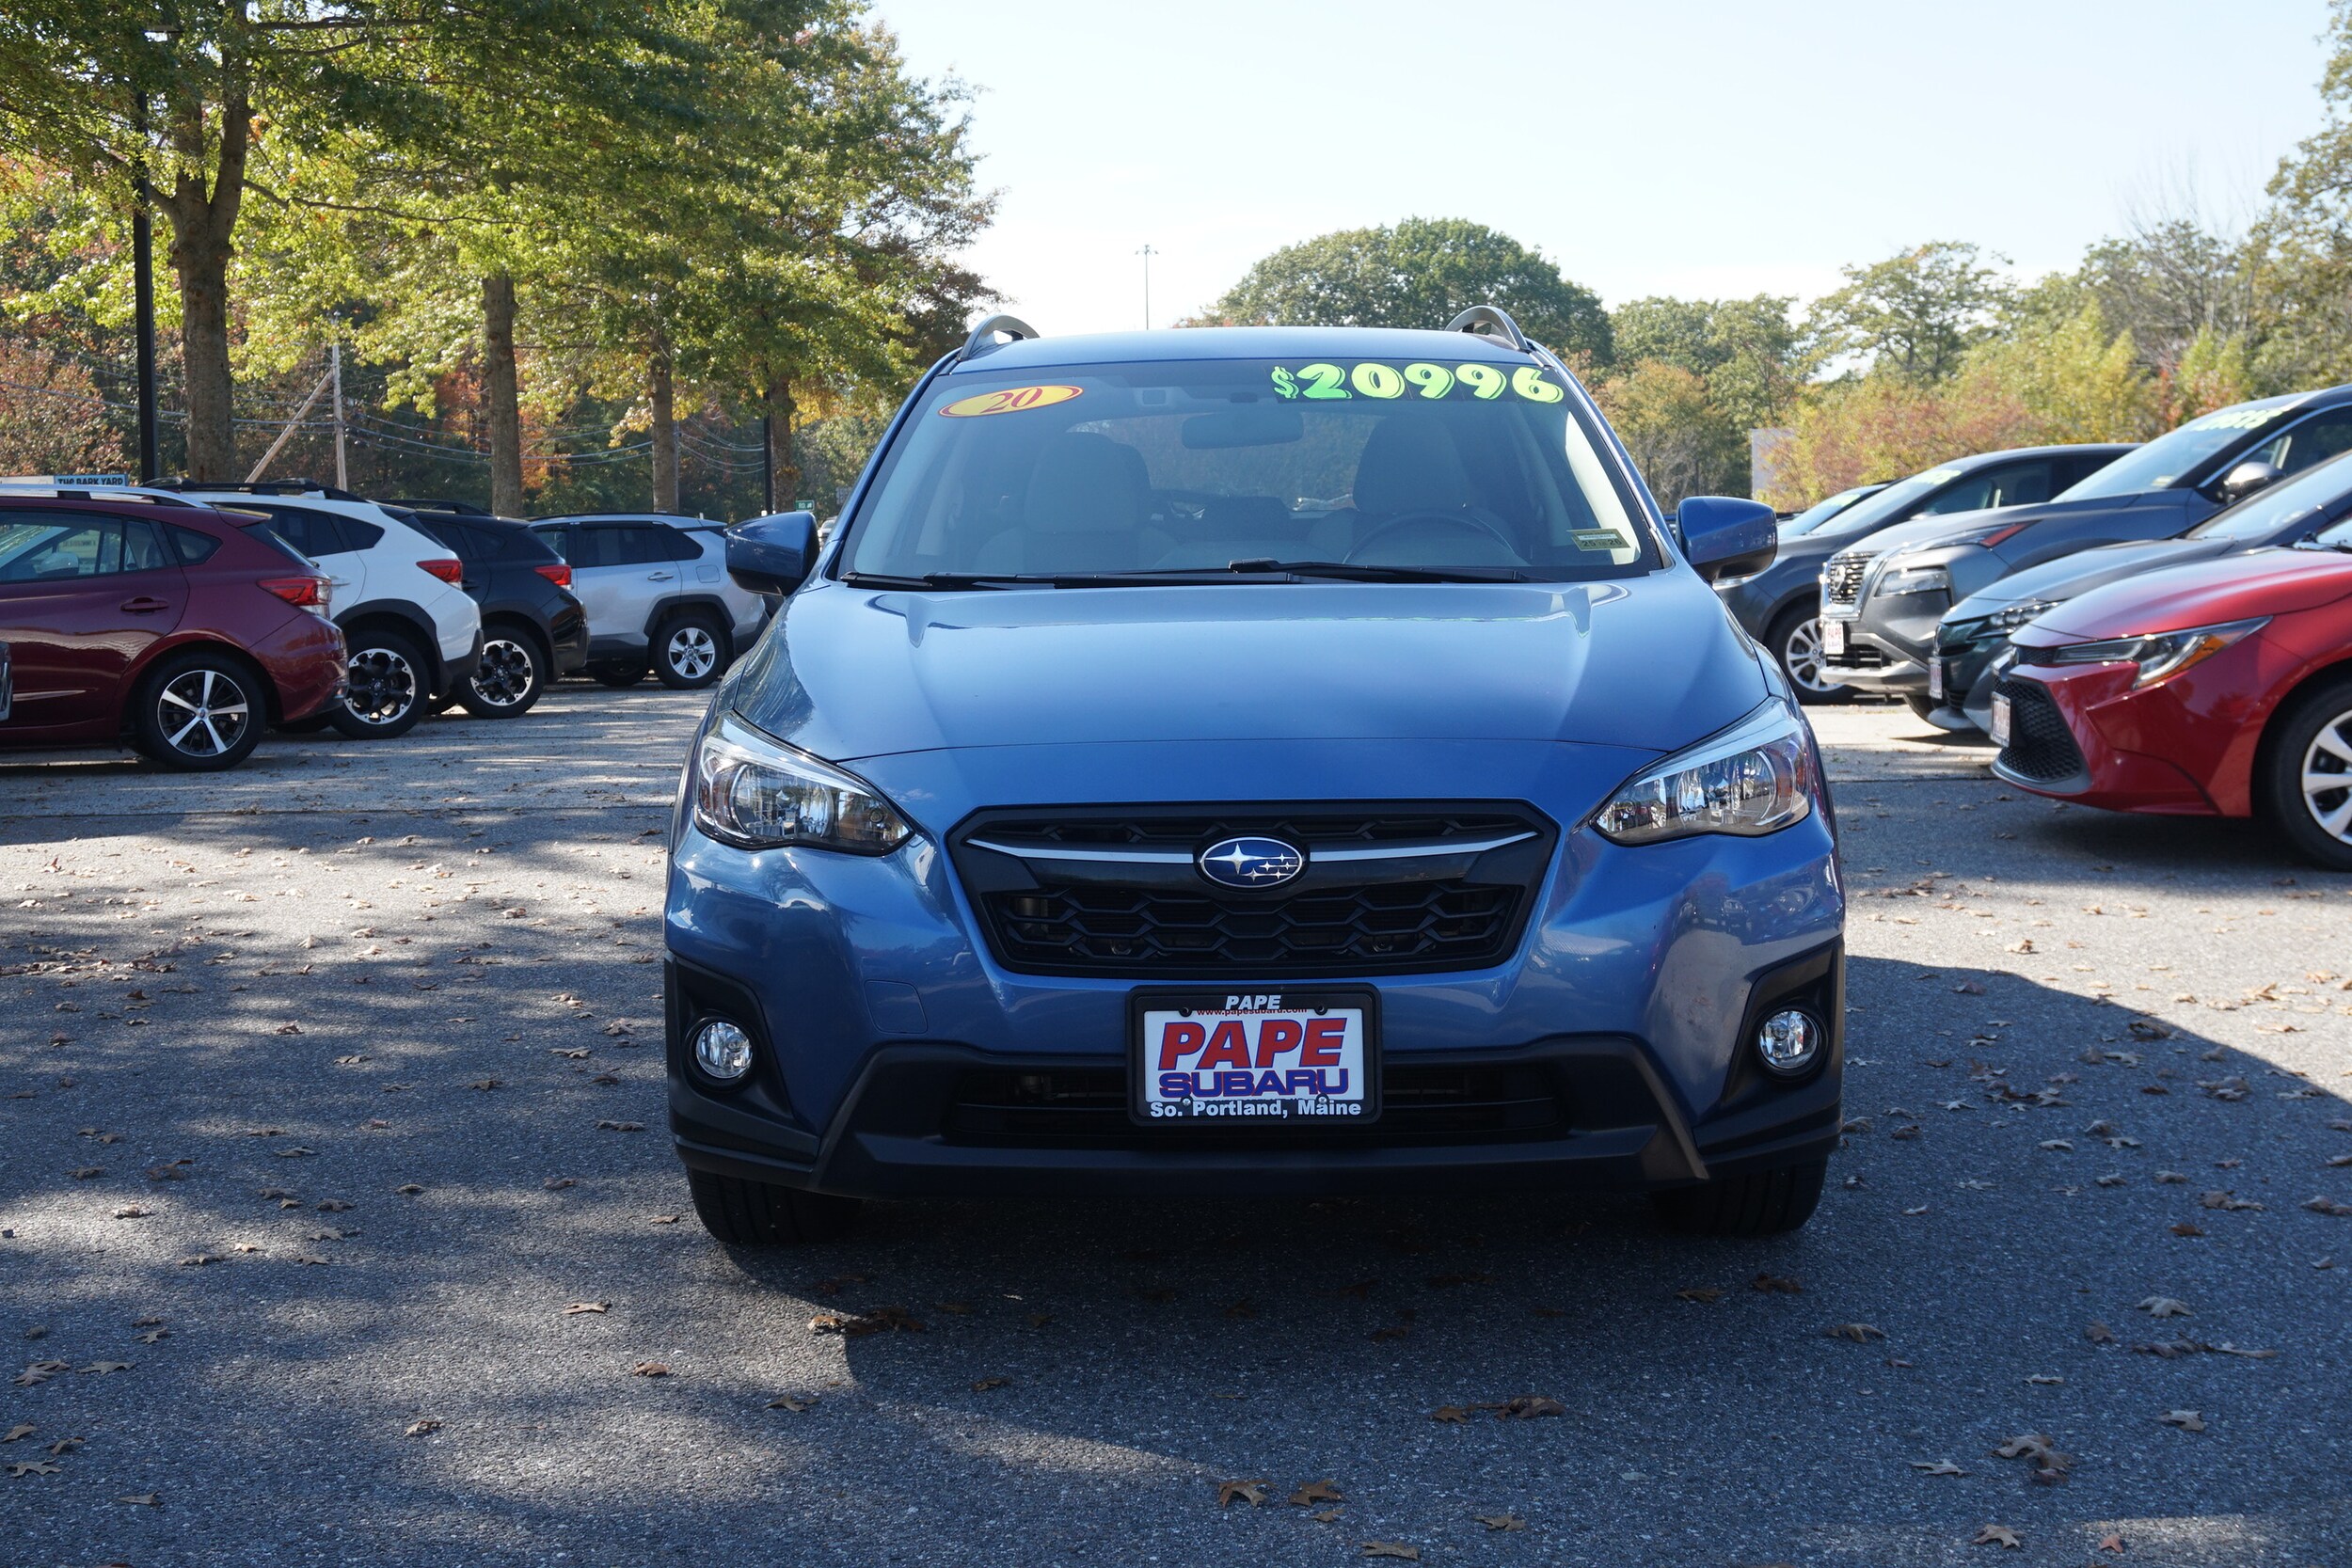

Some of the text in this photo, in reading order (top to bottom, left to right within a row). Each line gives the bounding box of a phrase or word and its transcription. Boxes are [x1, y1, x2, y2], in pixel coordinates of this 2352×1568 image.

[1271, 363, 1565, 404] $20996
[979, 388, 1043, 414] 20
[101, 477, 123, 485] YARD
[1225, 995, 1281, 1009] PAPE
[1158, 1018, 1348, 1070] PAPE
[1159, 1069, 1349, 1098] SUBARU
[1150, 1099, 1361, 1118] So. Portland, Maine
